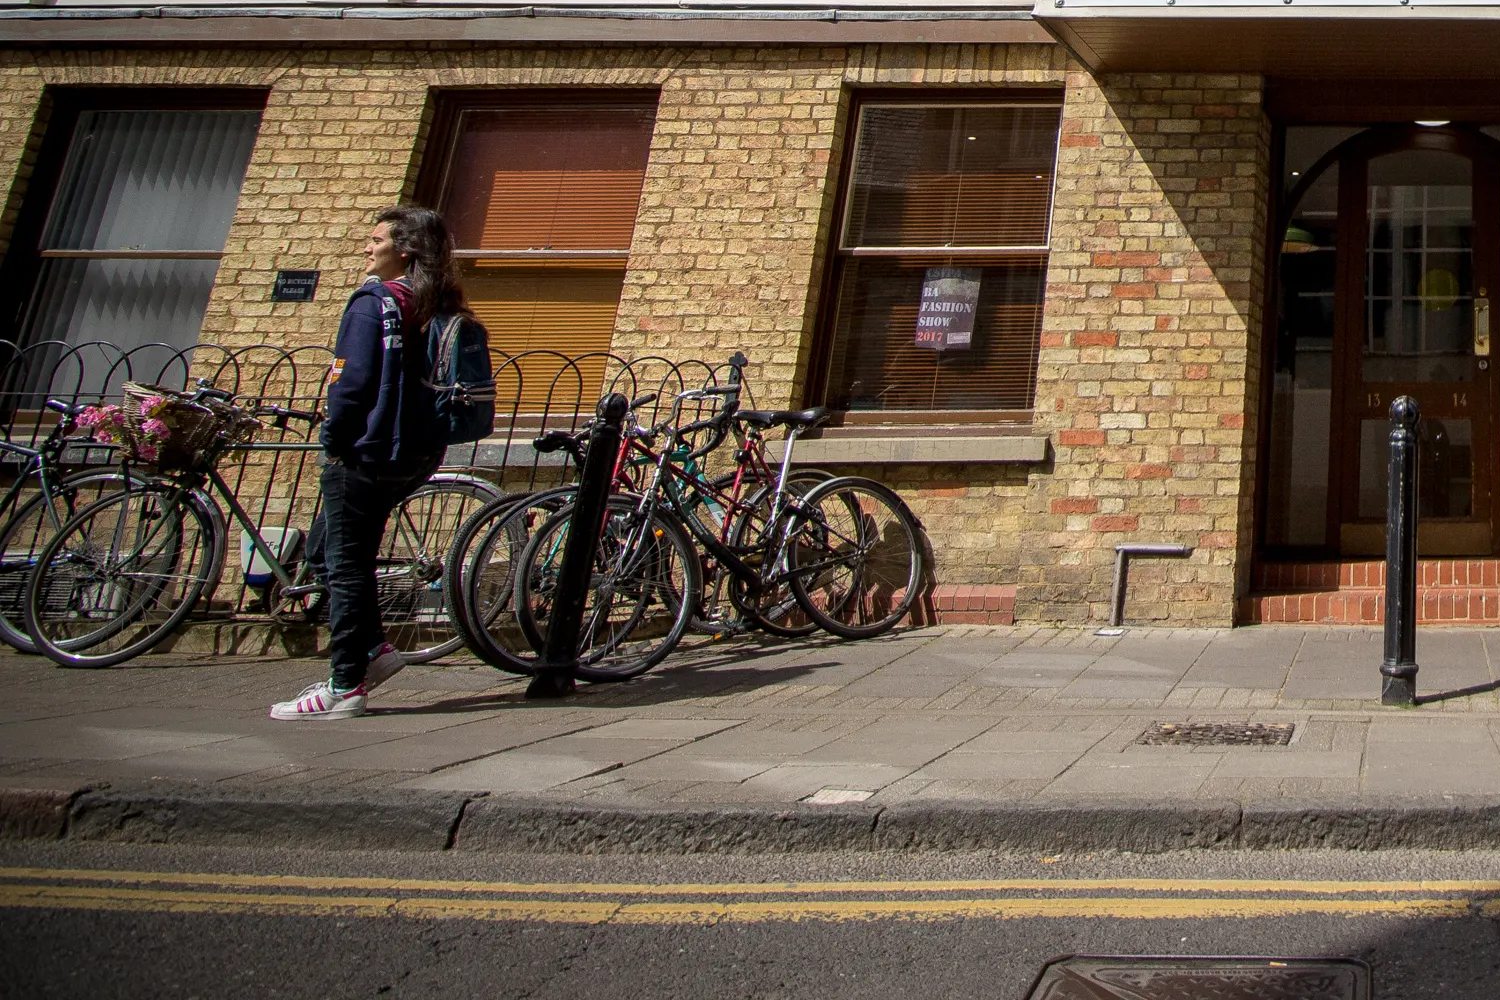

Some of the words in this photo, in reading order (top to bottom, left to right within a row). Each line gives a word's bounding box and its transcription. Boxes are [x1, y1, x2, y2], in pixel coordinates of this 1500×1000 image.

[924, 287, 939, 297] BA
[920, 302, 973, 313] FASHION
[918, 317, 952, 327] SHOW
[917, 331, 943, 342] 2017
[1367, 393, 1381, 408] 13
[1453, 392, 1467, 408] 14
